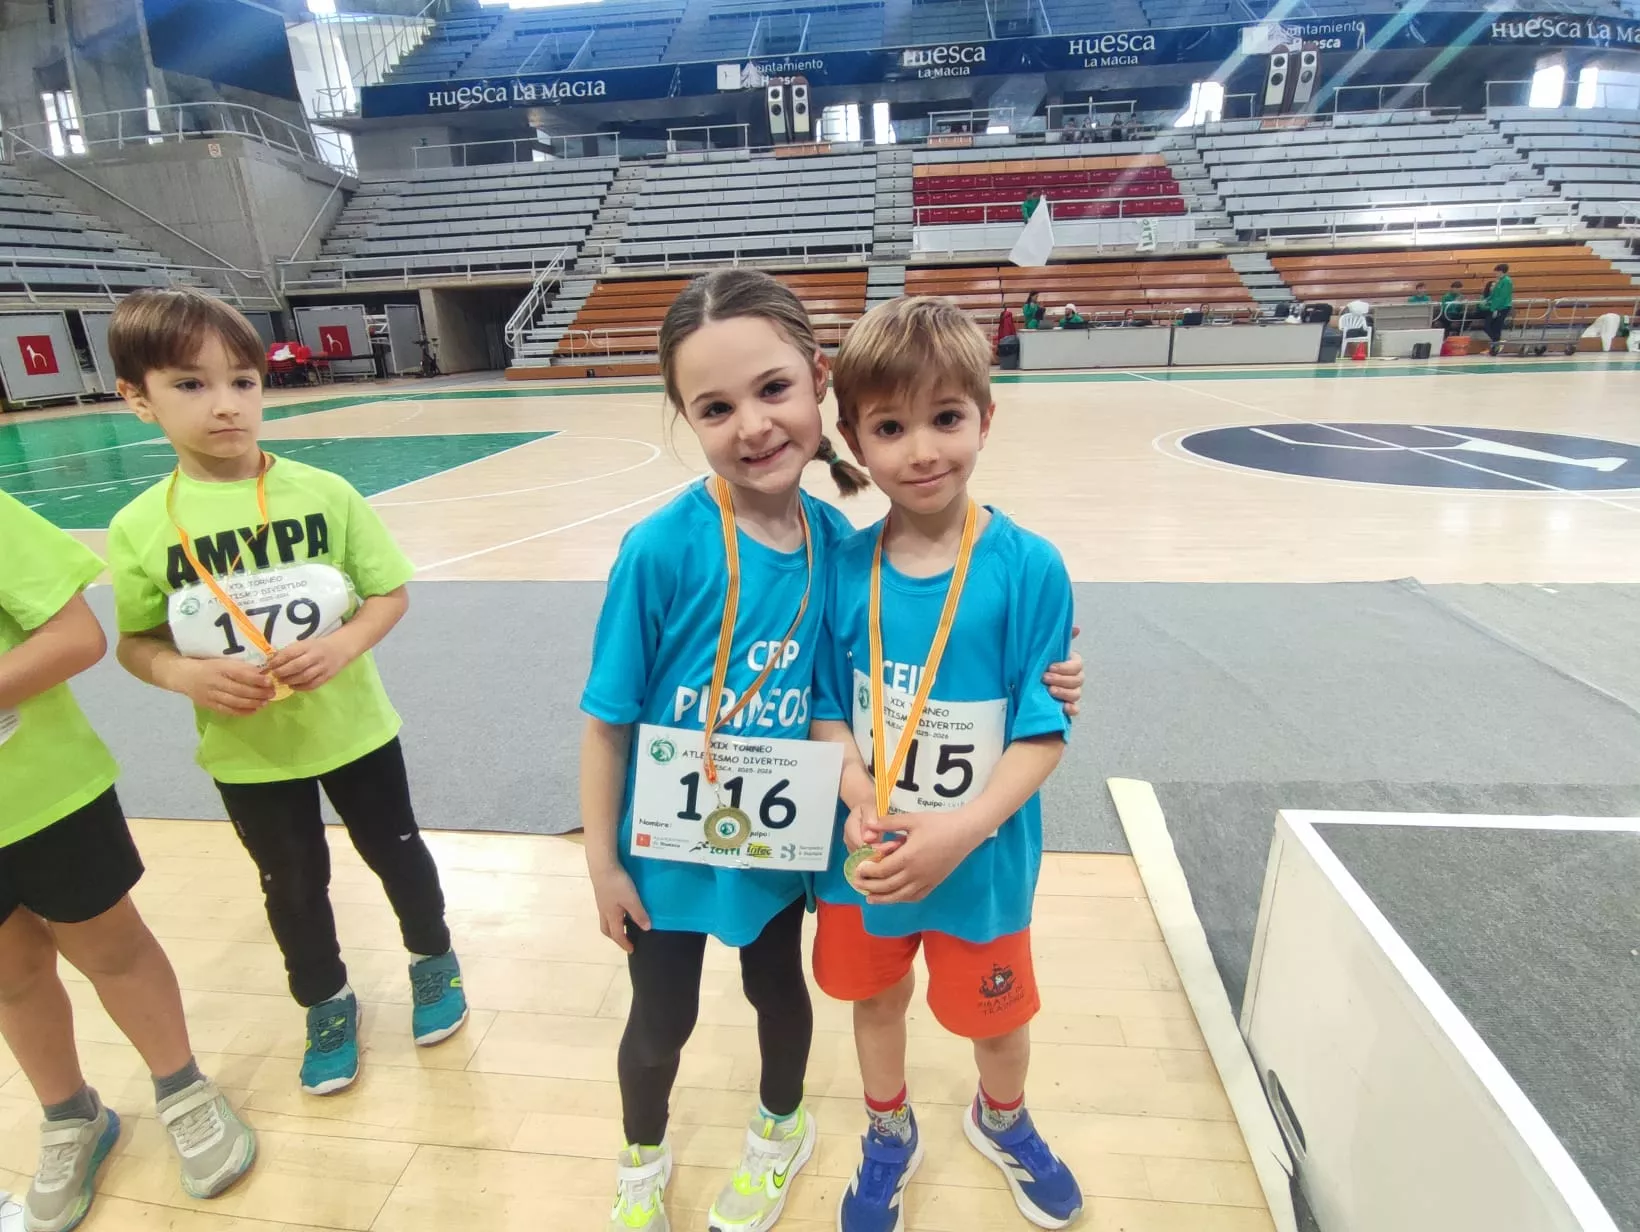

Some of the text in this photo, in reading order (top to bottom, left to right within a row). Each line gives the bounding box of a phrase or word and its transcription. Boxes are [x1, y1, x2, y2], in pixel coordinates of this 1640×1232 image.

[1491, 17, 1581, 38] Huesca
[1068, 33, 1156, 55] Huesca
[903, 45, 986, 66] Huesca
[428, 86, 507, 107] Huesca
[167, 513, 328, 589] AMYPA
[214, 598, 321, 655] 179
[890, 696, 905, 707] XIX
[919, 718, 973, 730] DIVERTIDO
[710, 741, 773, 753] XIX TORNEO
[743, 757, 798, 767] DIVERTIDO
[677, 771, 797, 829] 116
